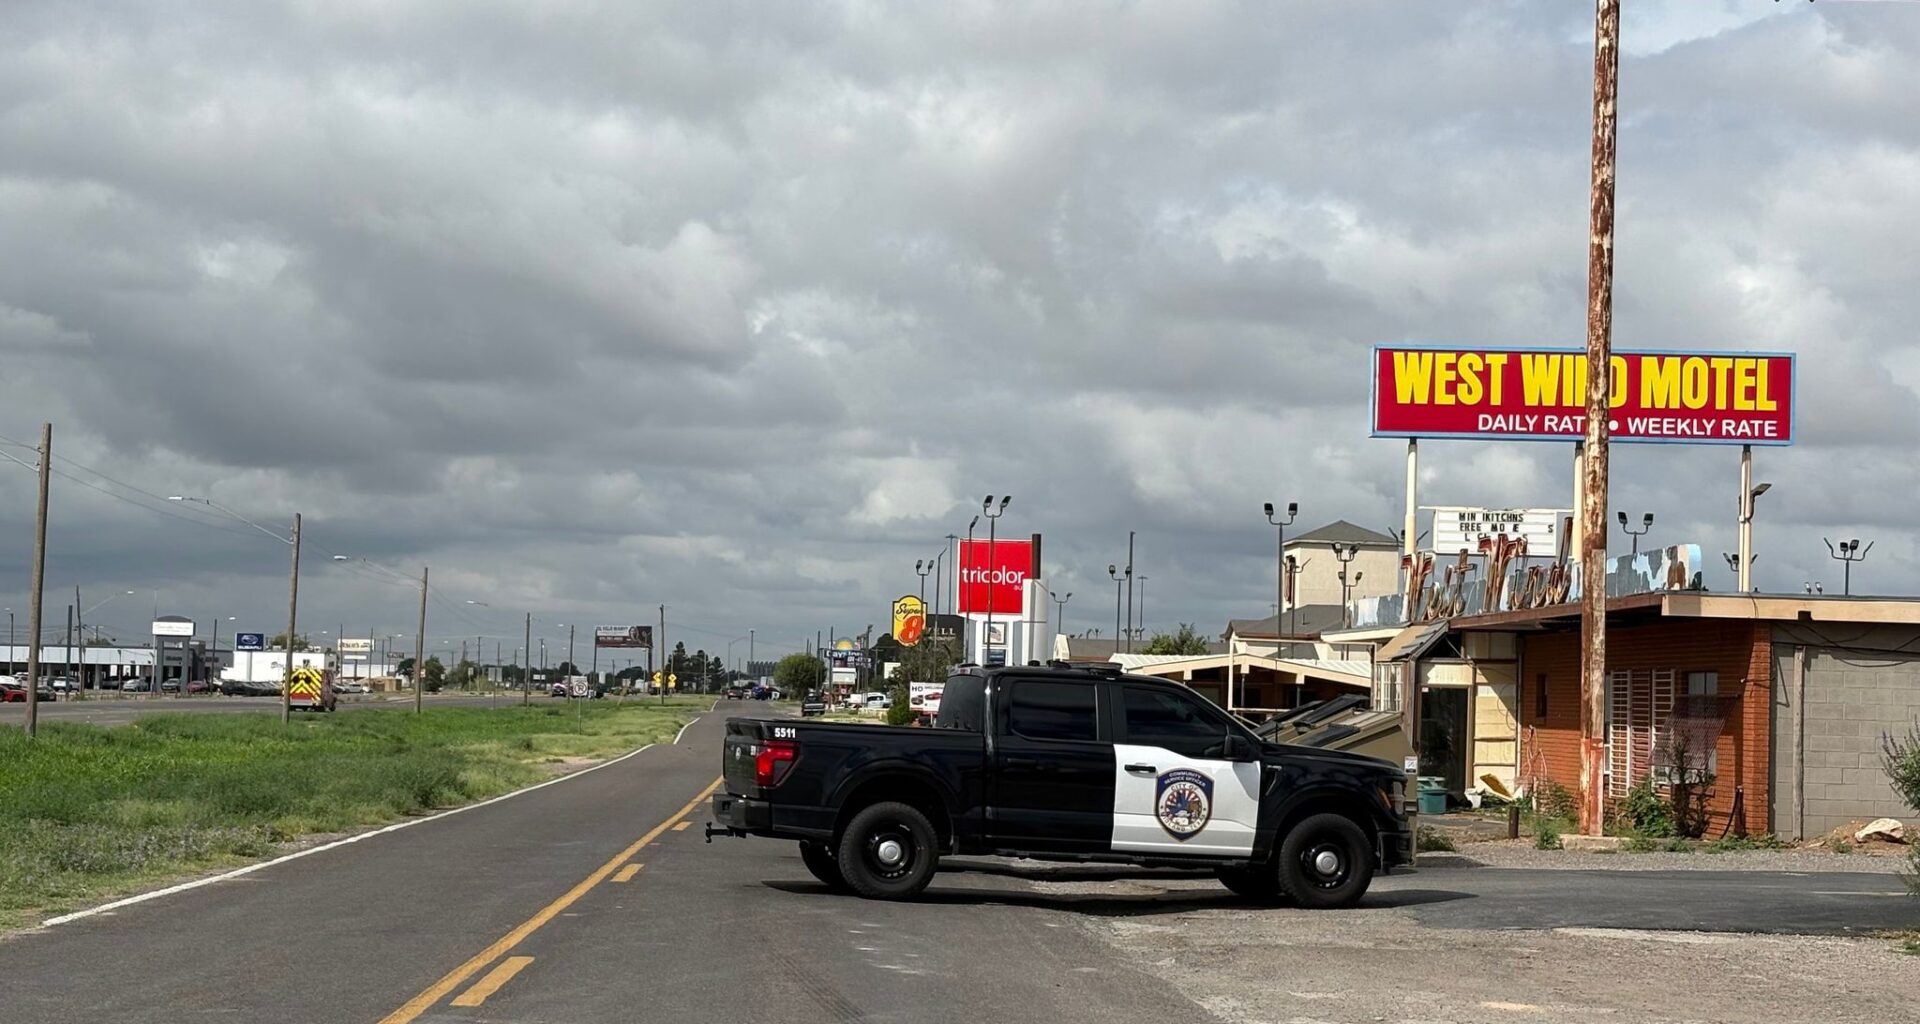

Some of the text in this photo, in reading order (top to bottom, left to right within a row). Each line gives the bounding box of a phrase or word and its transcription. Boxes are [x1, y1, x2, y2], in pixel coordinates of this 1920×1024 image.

[1393, 352, 1777, 412] WEST WID MOTEL
[1477, 413, 1778, 438] DAILY RAT WEEKLY RATE
[1460, 522, 1482, 532] FREE
[962, 565, 1025, 585] tricolor
[899, 615, 924, 643] 8
[774, 727, 796, 738] 5511
